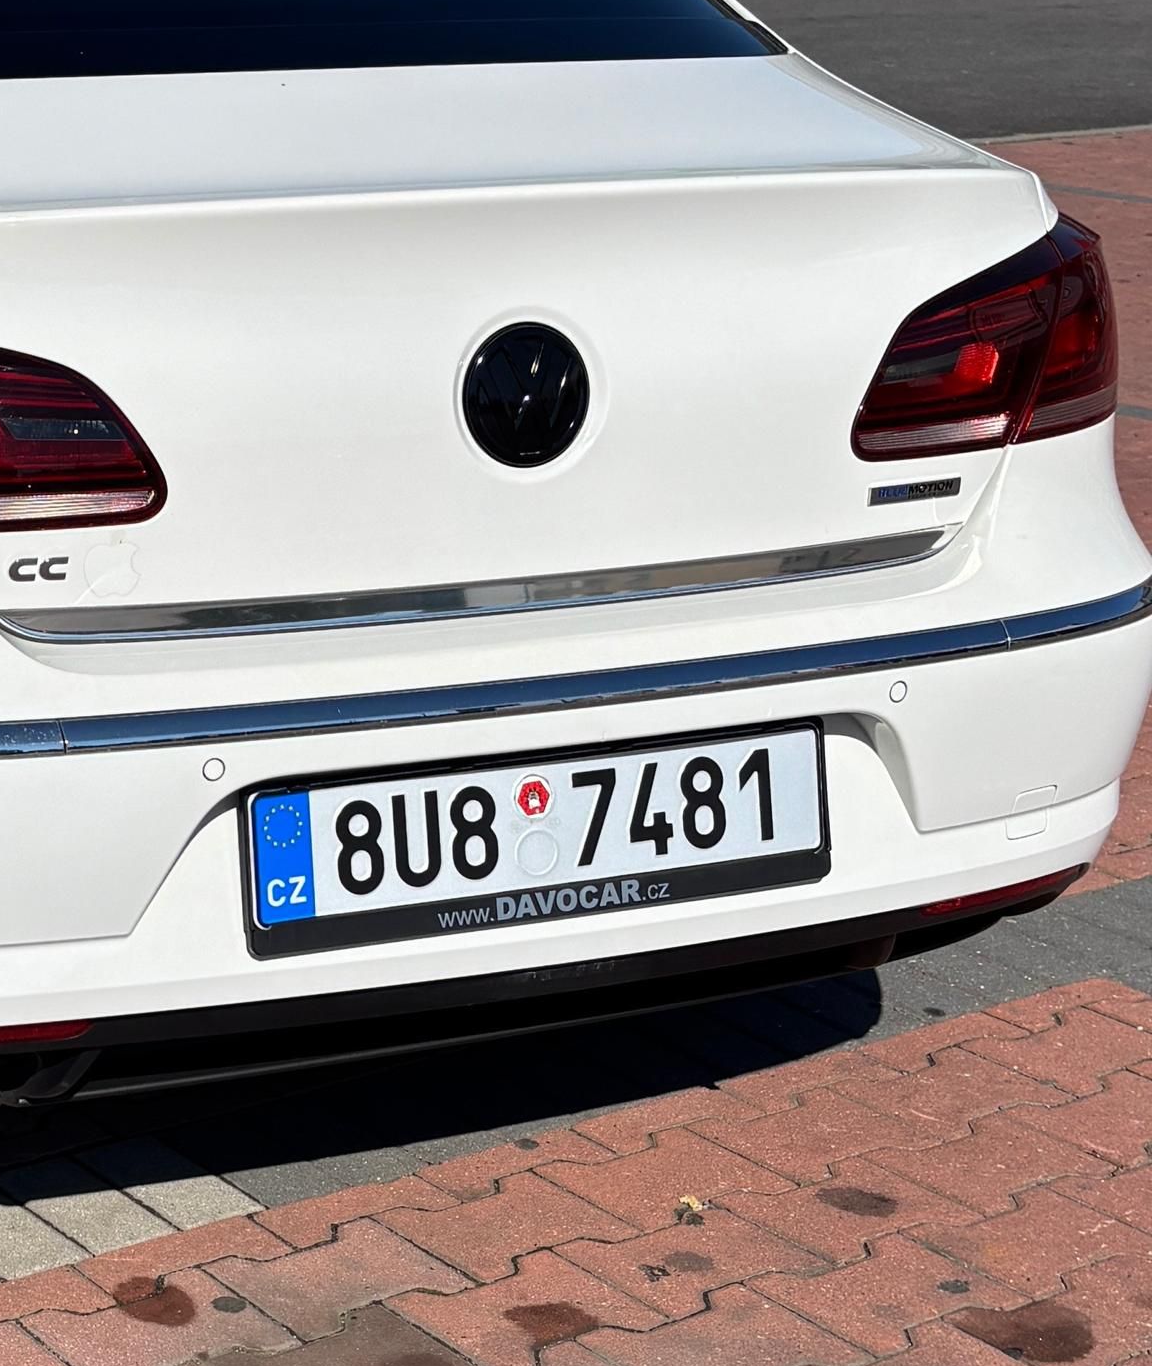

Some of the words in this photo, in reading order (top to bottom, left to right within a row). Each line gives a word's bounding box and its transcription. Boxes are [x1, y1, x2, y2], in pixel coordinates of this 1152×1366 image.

[8, 556, 69, 582] CC
[335, 785, 500, 896] 8U8
[571, 748, 775, 867] 7481
[266, 874, 308, 907] CZ
